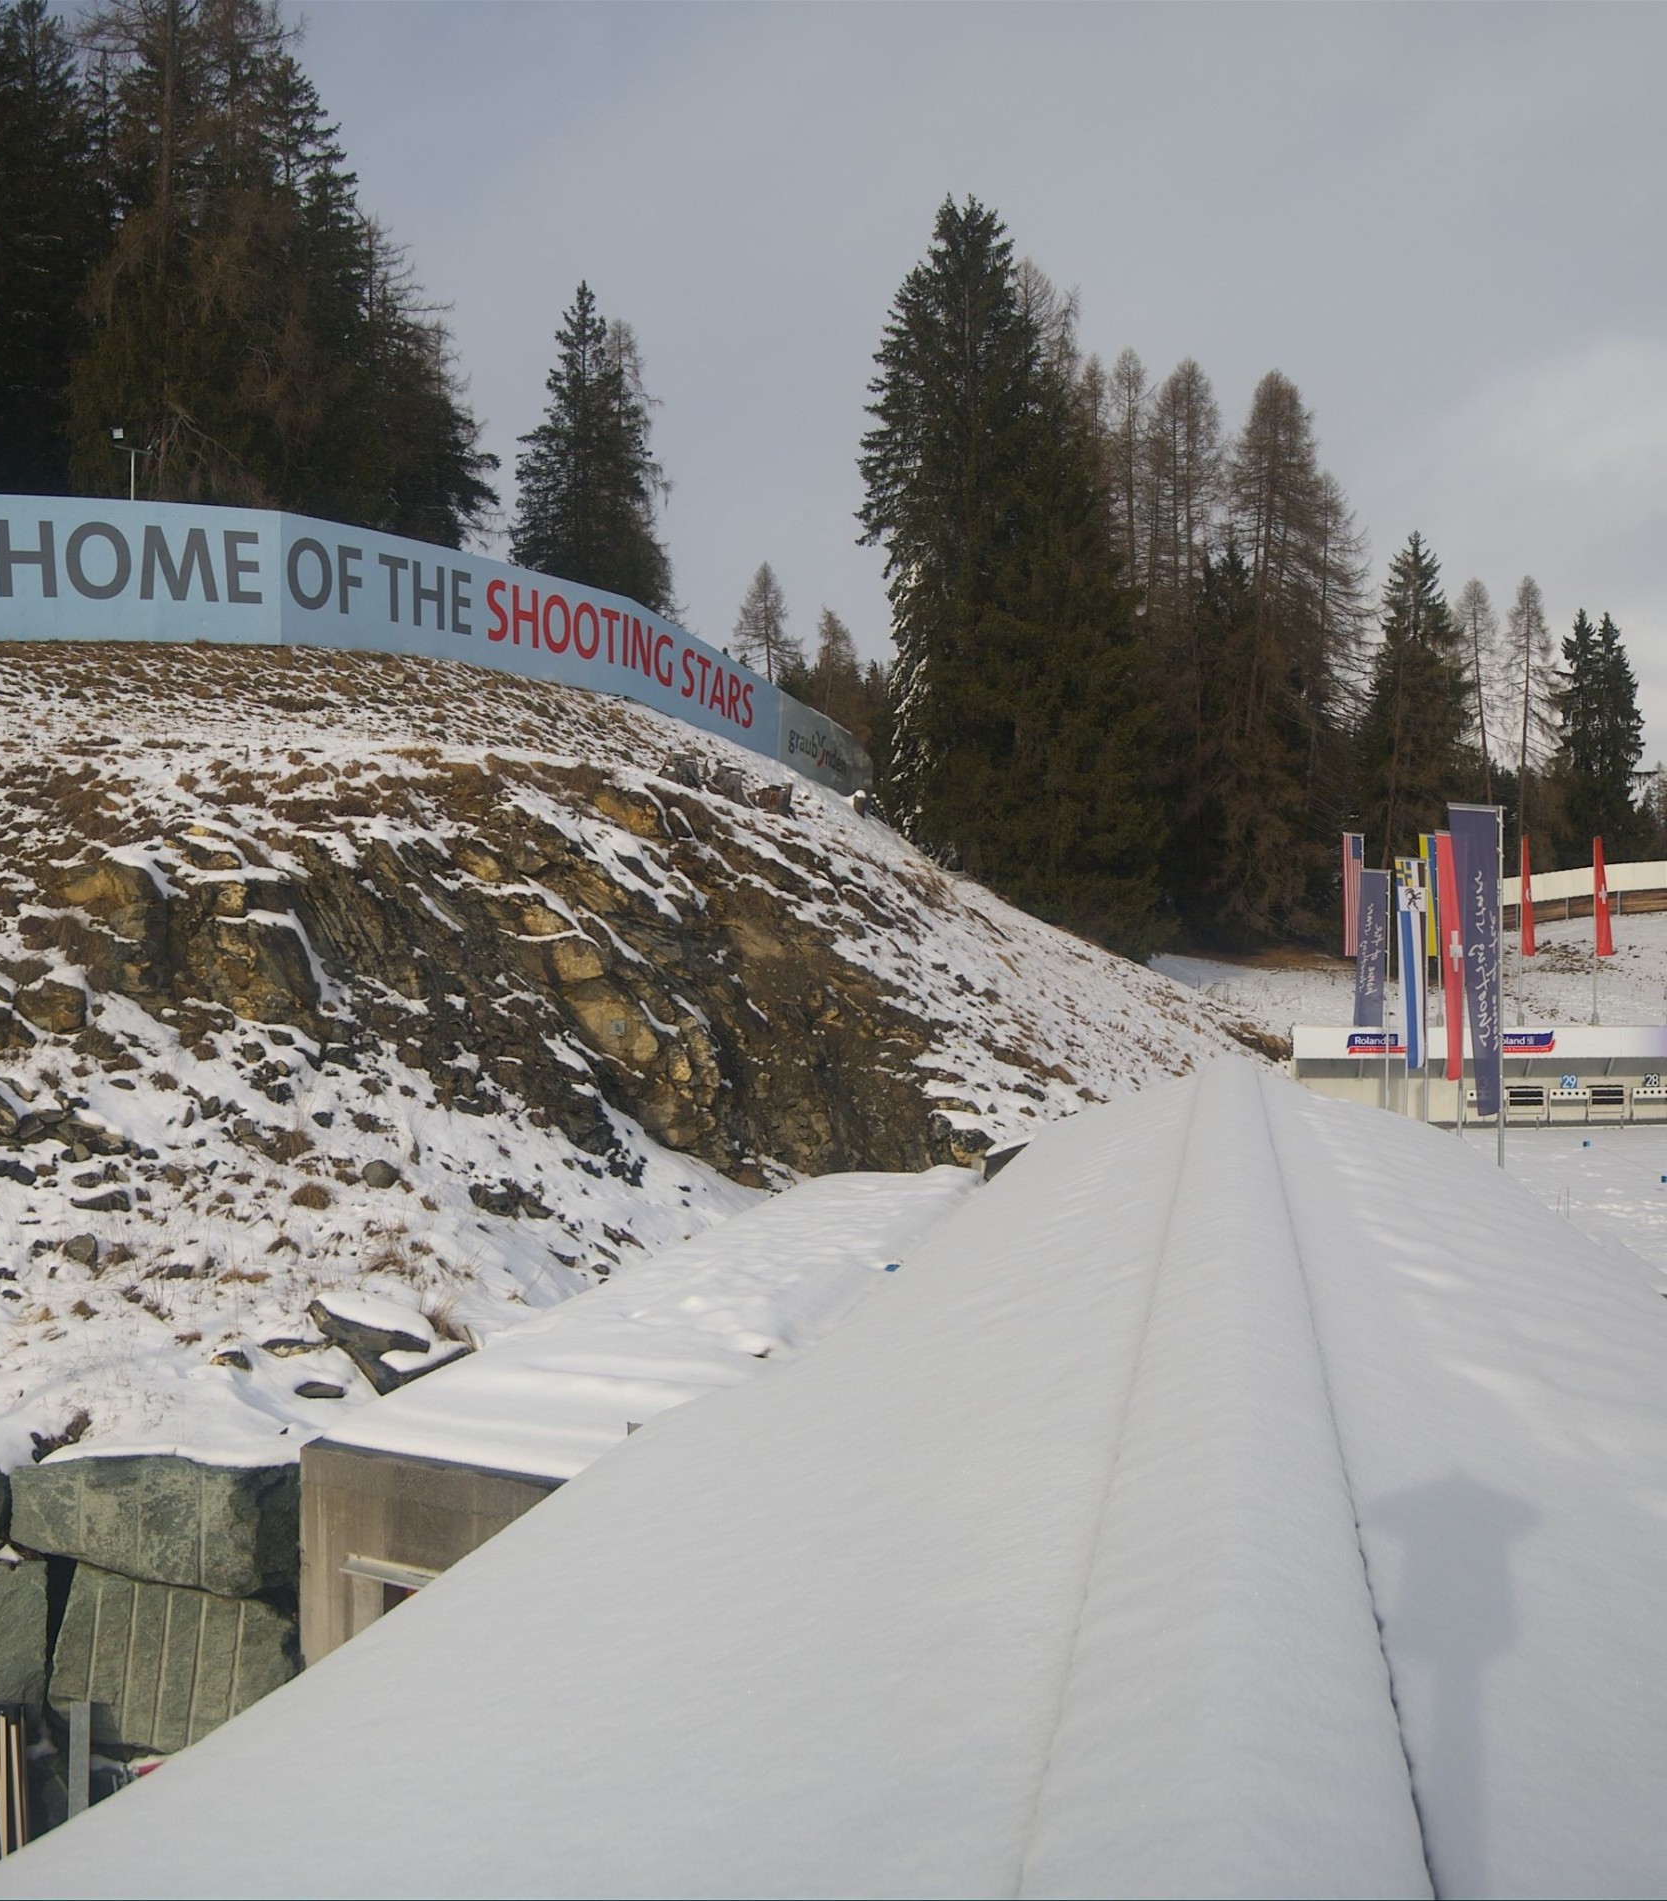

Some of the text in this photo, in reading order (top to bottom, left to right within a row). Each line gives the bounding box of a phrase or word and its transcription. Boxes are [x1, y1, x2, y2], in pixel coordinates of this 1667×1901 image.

[286, 536, 364, 616] OF
[377, 552, 474, 637] THE
[486, 579, 675, 688] SHOOTING
[680, 647, 755, 730] STARS
[1354, 1036, 1386, 1045] Roland
[1562, 1075, 1577, 1088] 29
[1644, 1074, 1659, 1087] 28
